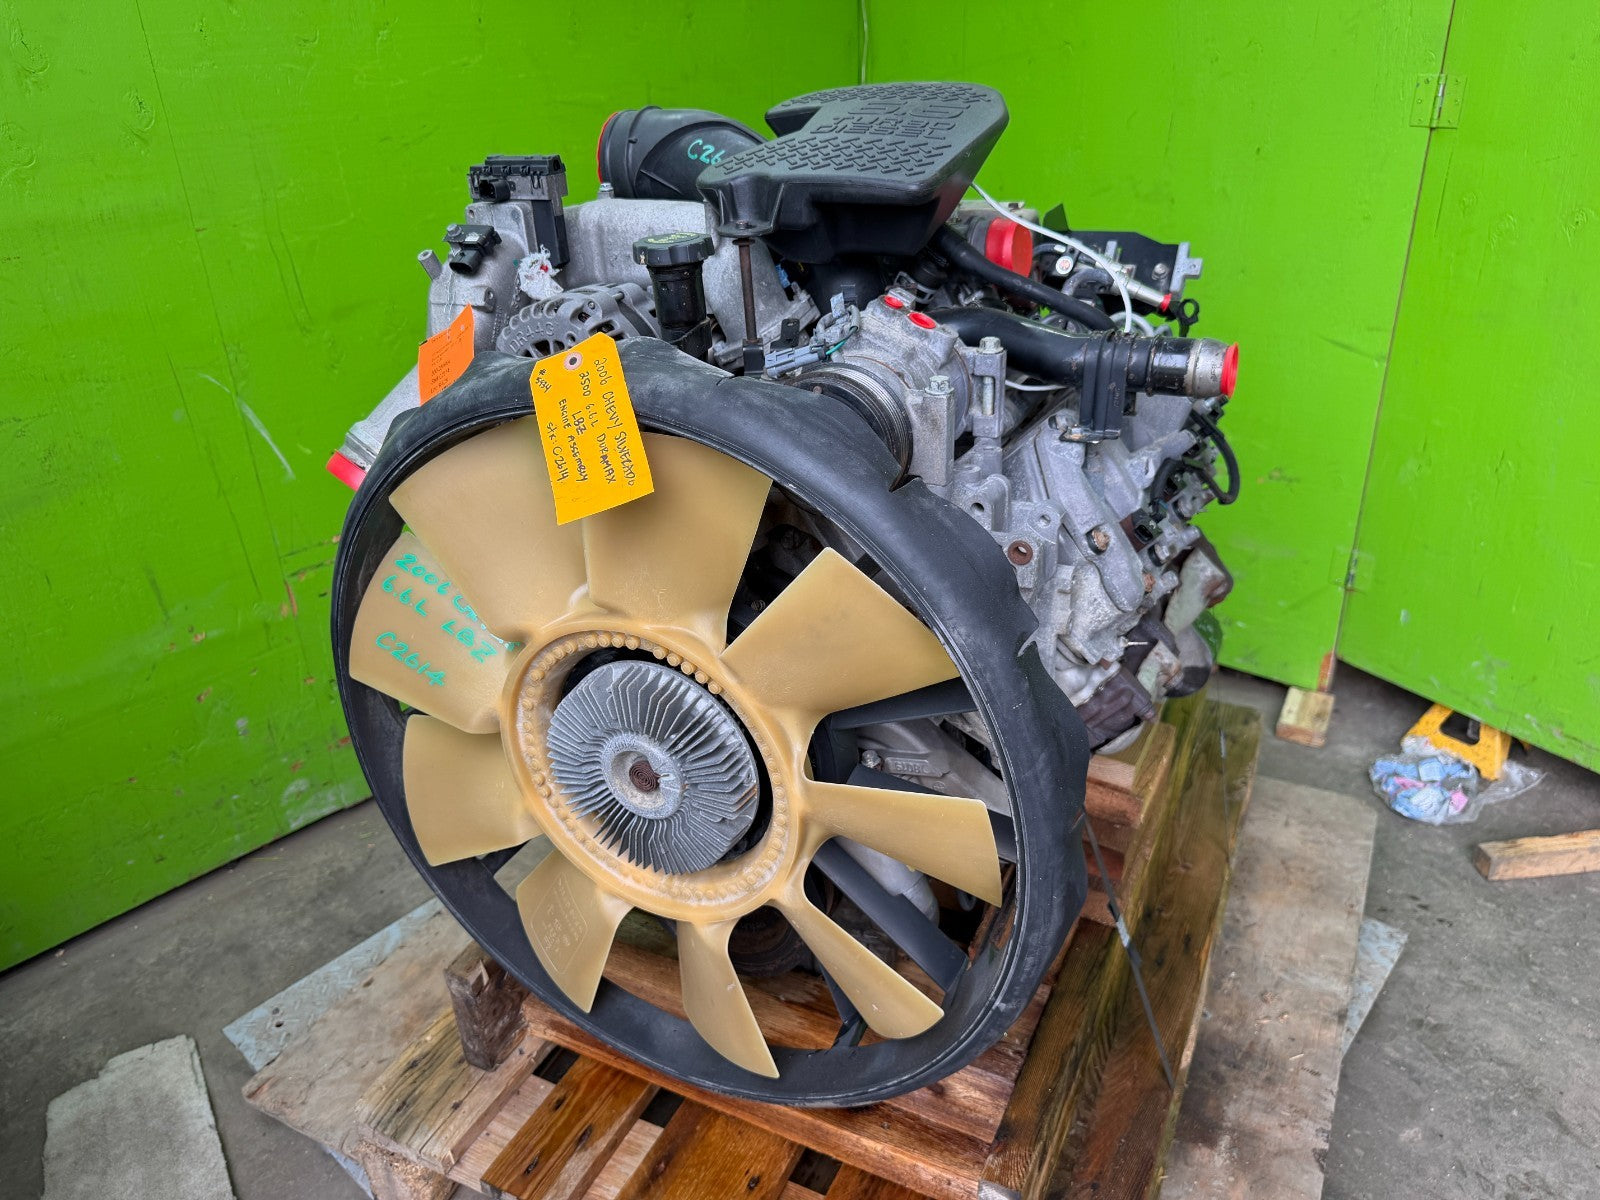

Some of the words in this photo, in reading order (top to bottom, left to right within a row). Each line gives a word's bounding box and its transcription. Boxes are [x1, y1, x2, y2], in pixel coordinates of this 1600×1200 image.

[593, 357, 614, 386] 2006
[571, 411, 588, 436] LBZ
[602, 391, 623, 430] CHEVY
[375, 631, 446, 687] C2614
